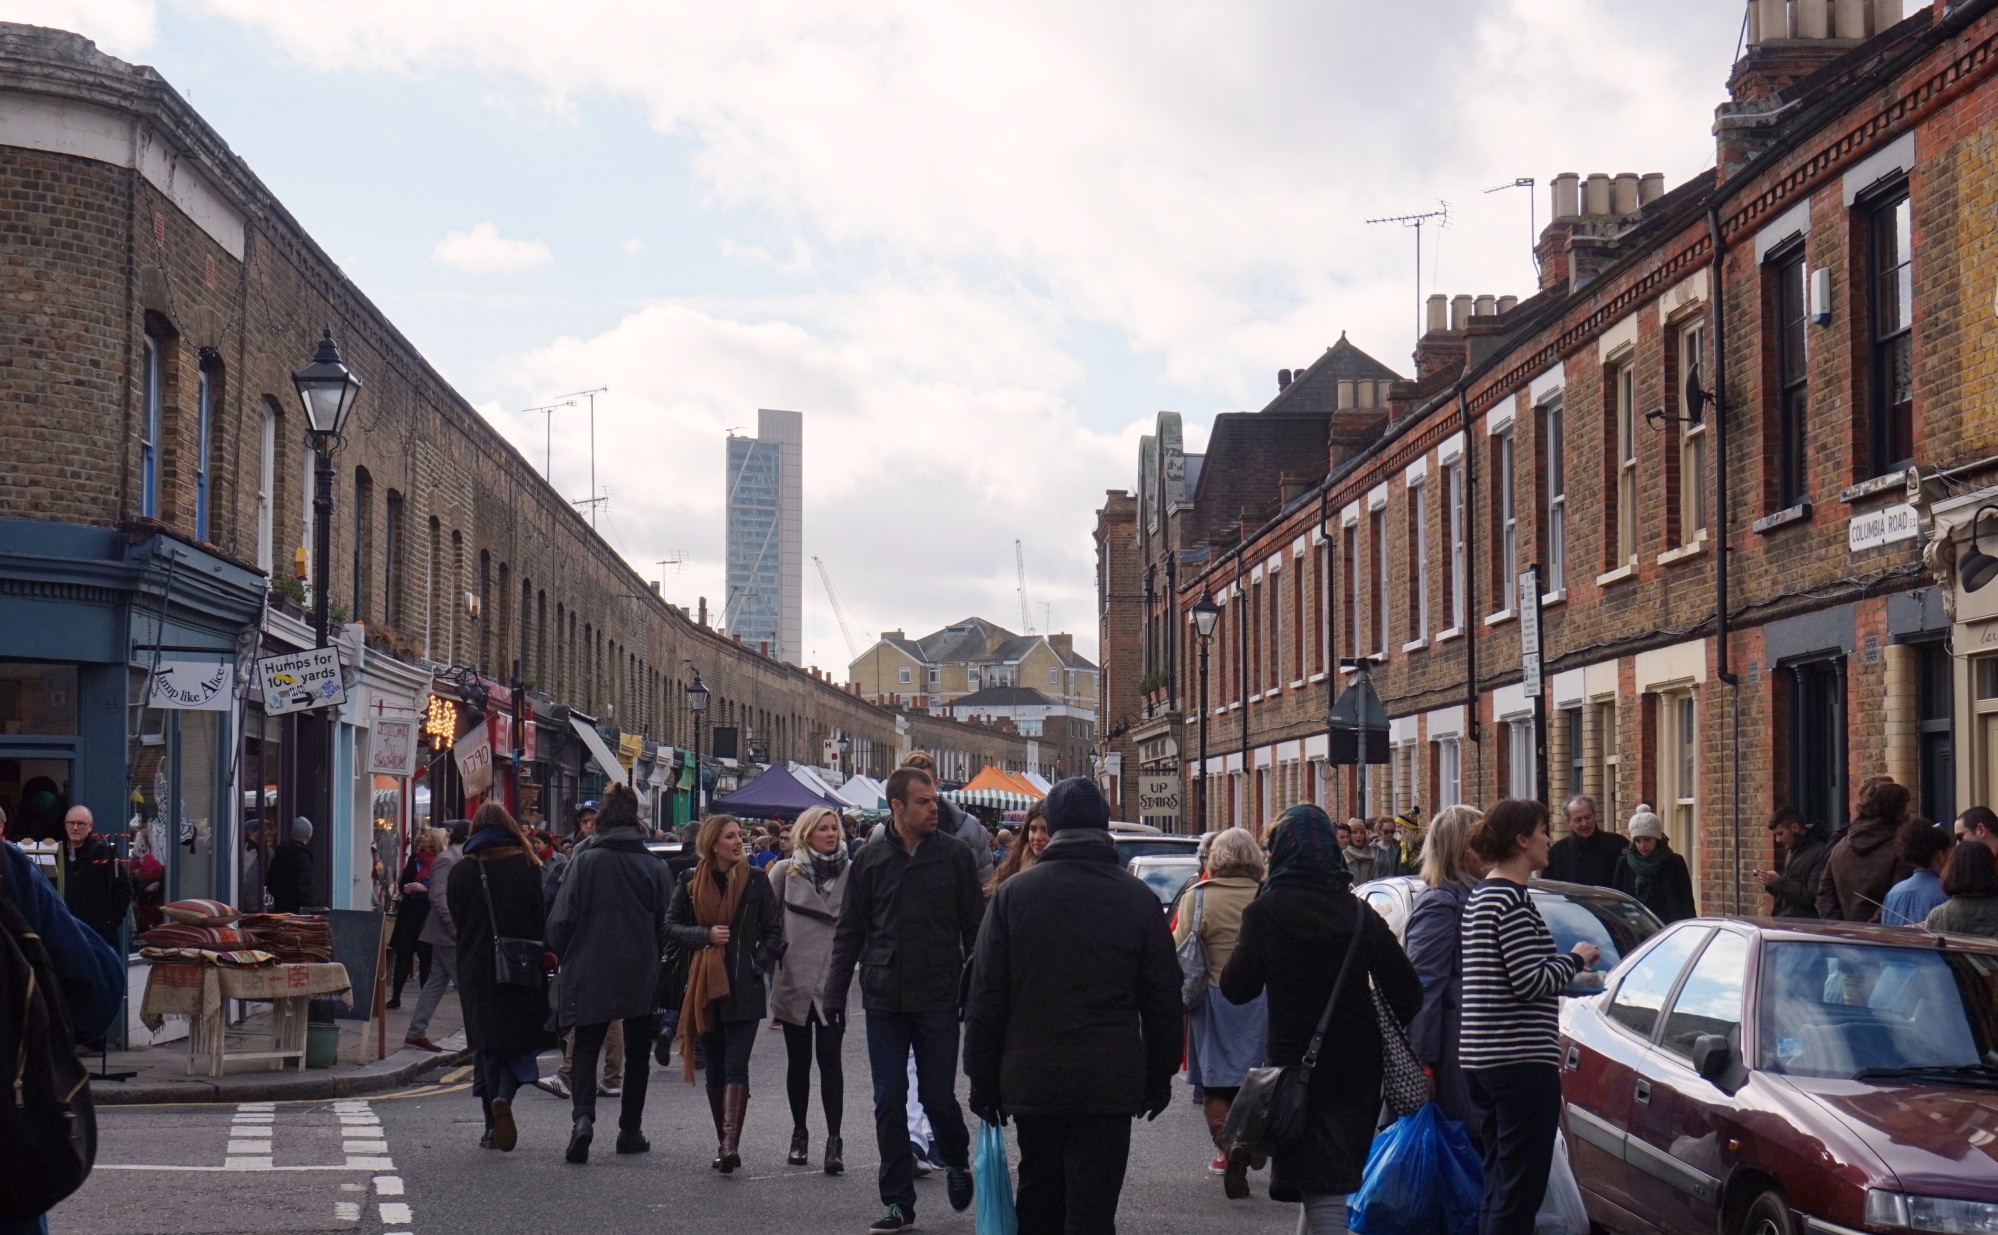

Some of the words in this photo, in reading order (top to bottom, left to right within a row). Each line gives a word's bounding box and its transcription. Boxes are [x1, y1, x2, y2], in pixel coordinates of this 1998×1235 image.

[1851, 518, 1885, 543] COLUMBIA
[1888, 511, 1908, 533] ROAD
[265, 659, 311, 674] Humps
[314, 654, 332, 666] for
[301, 667, 336, 684] yards
[180, 690, 201, 702] like
[200, 668, 225, 700] Alice
[1150, 782, 1168, 793] UP
[1140, 794, 1178, 810] STAIRS
